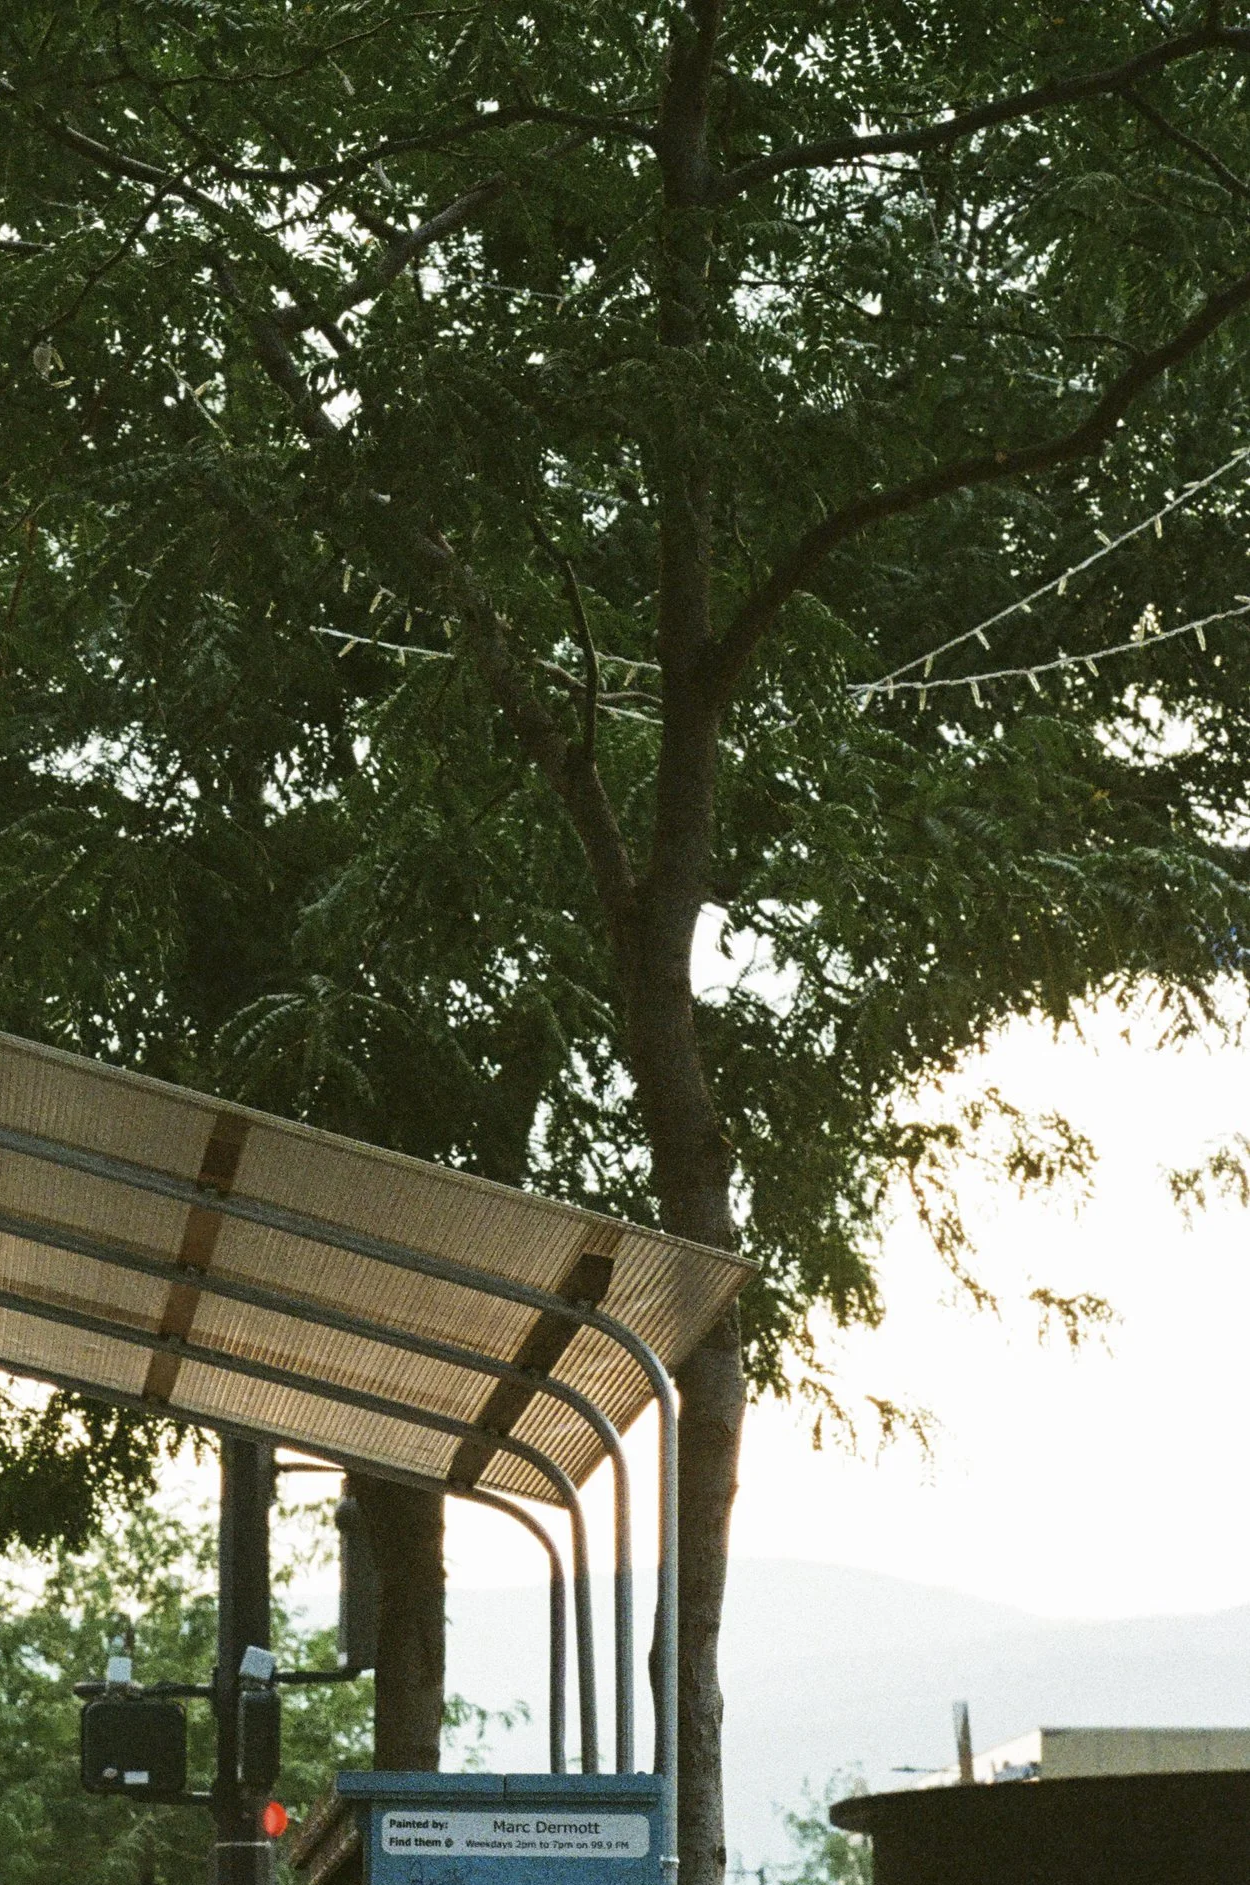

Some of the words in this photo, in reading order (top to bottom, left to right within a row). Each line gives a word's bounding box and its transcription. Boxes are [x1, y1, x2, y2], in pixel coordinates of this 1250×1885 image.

[389, 1819, 429, 1829] Painted
[431, 1819, 449, 1831] by:
[493, 1821, 531, 1834] Marc
[536, 1821, 601, 1834] Dermott
[389, 1837, 411, 1847] Find
[414, 1837, 442, 1847] them
[465, 1840, 513, 1849] Weekdays
[515, 1840, 537, 1850] 2pm
[539, 1840, 550, 1849] to
[553, 1840, 574, 1850] 7pm
[576, 1842, 588, 1850] on
[615, 1841, 630, 1850] FM
